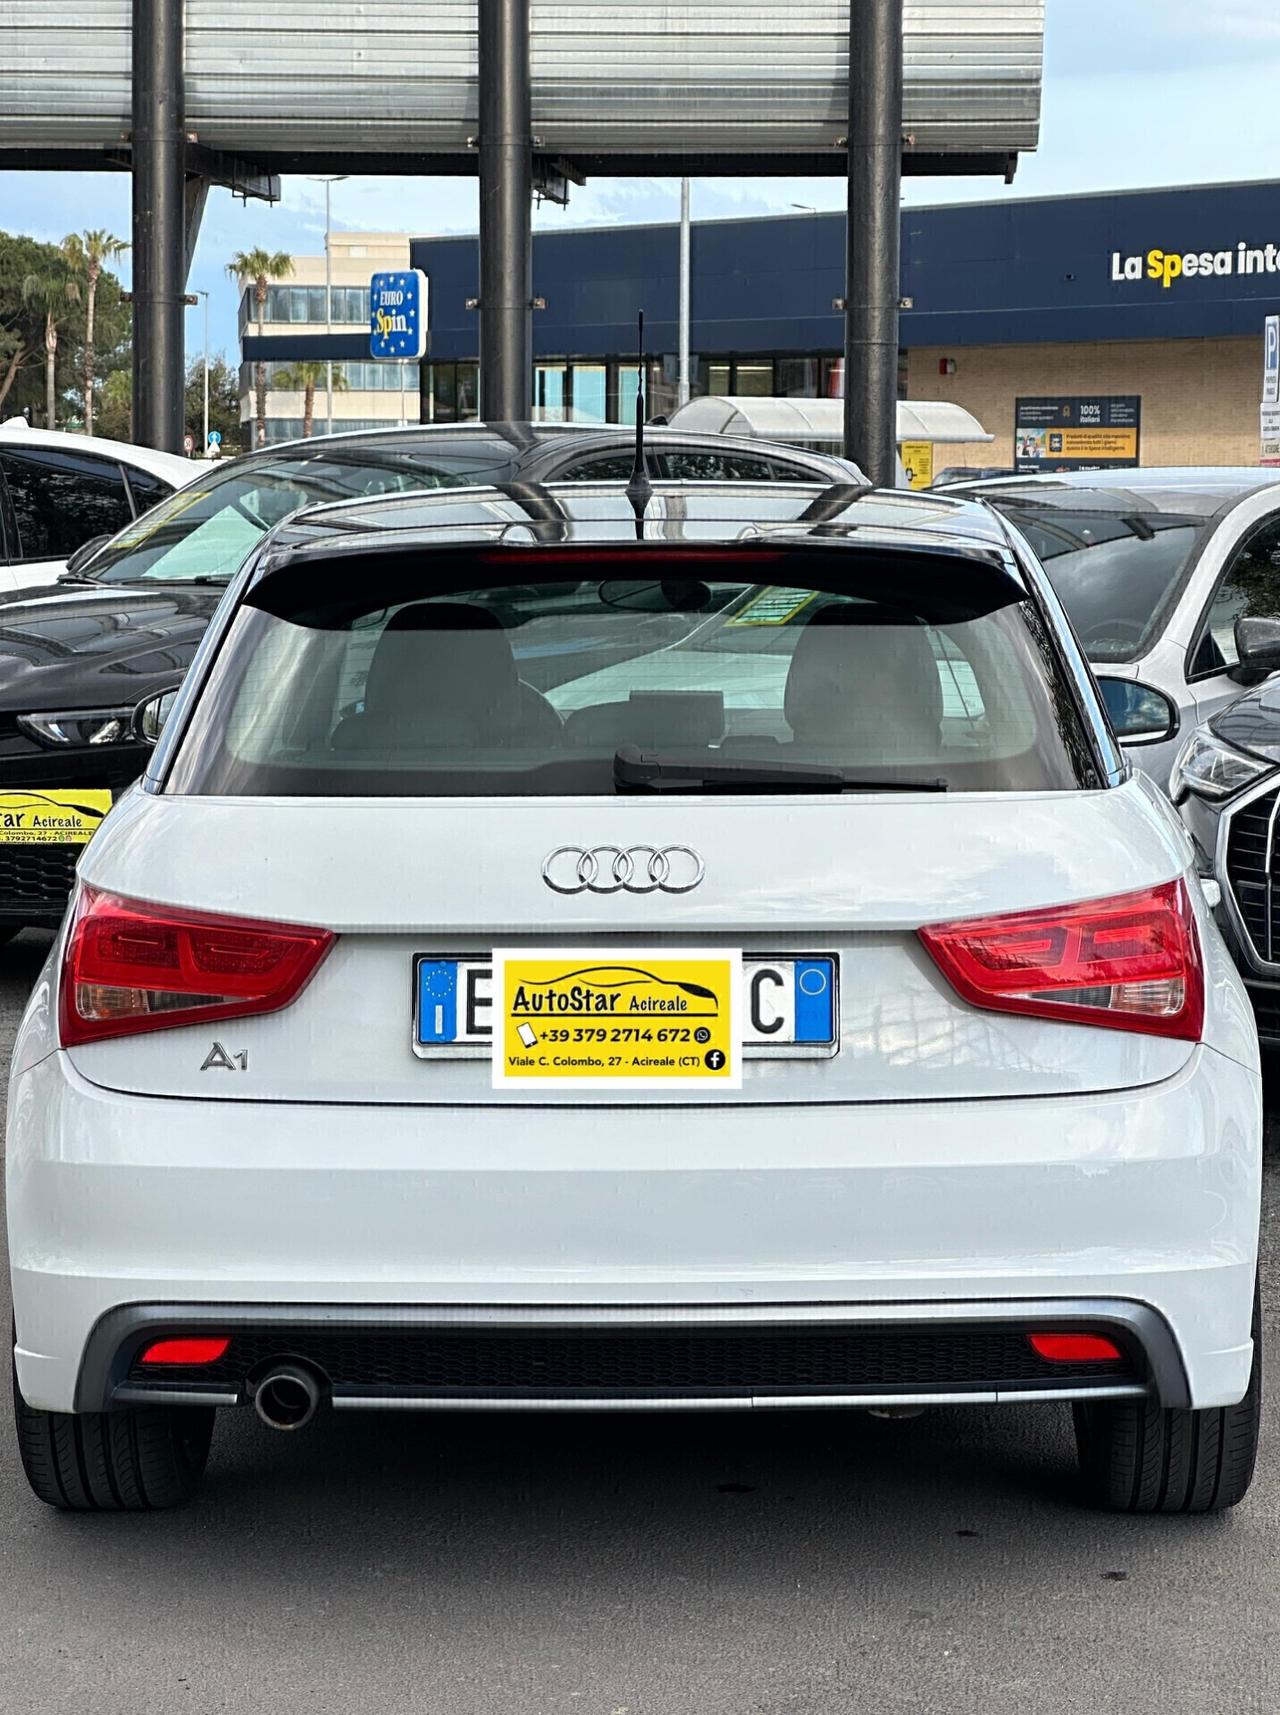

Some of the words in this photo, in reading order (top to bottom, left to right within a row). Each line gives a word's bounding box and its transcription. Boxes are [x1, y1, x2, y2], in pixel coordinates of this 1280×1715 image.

[1112, 252, 1142, 280] La
[1147, 249, 1232, 288] Spesa
[1237, 242, 1280, 274] int
[380, 290, 403, 306] EURO
[376, 307, 407, 339] Spin
[1080, 405, 1100, 415] 100%
[1080, 415, 1100, 423] italiani
[33, 815, 82, 827] Acireale
[751, 968, 784, 1034] C
[200, 1042, 248, 1071] A1
